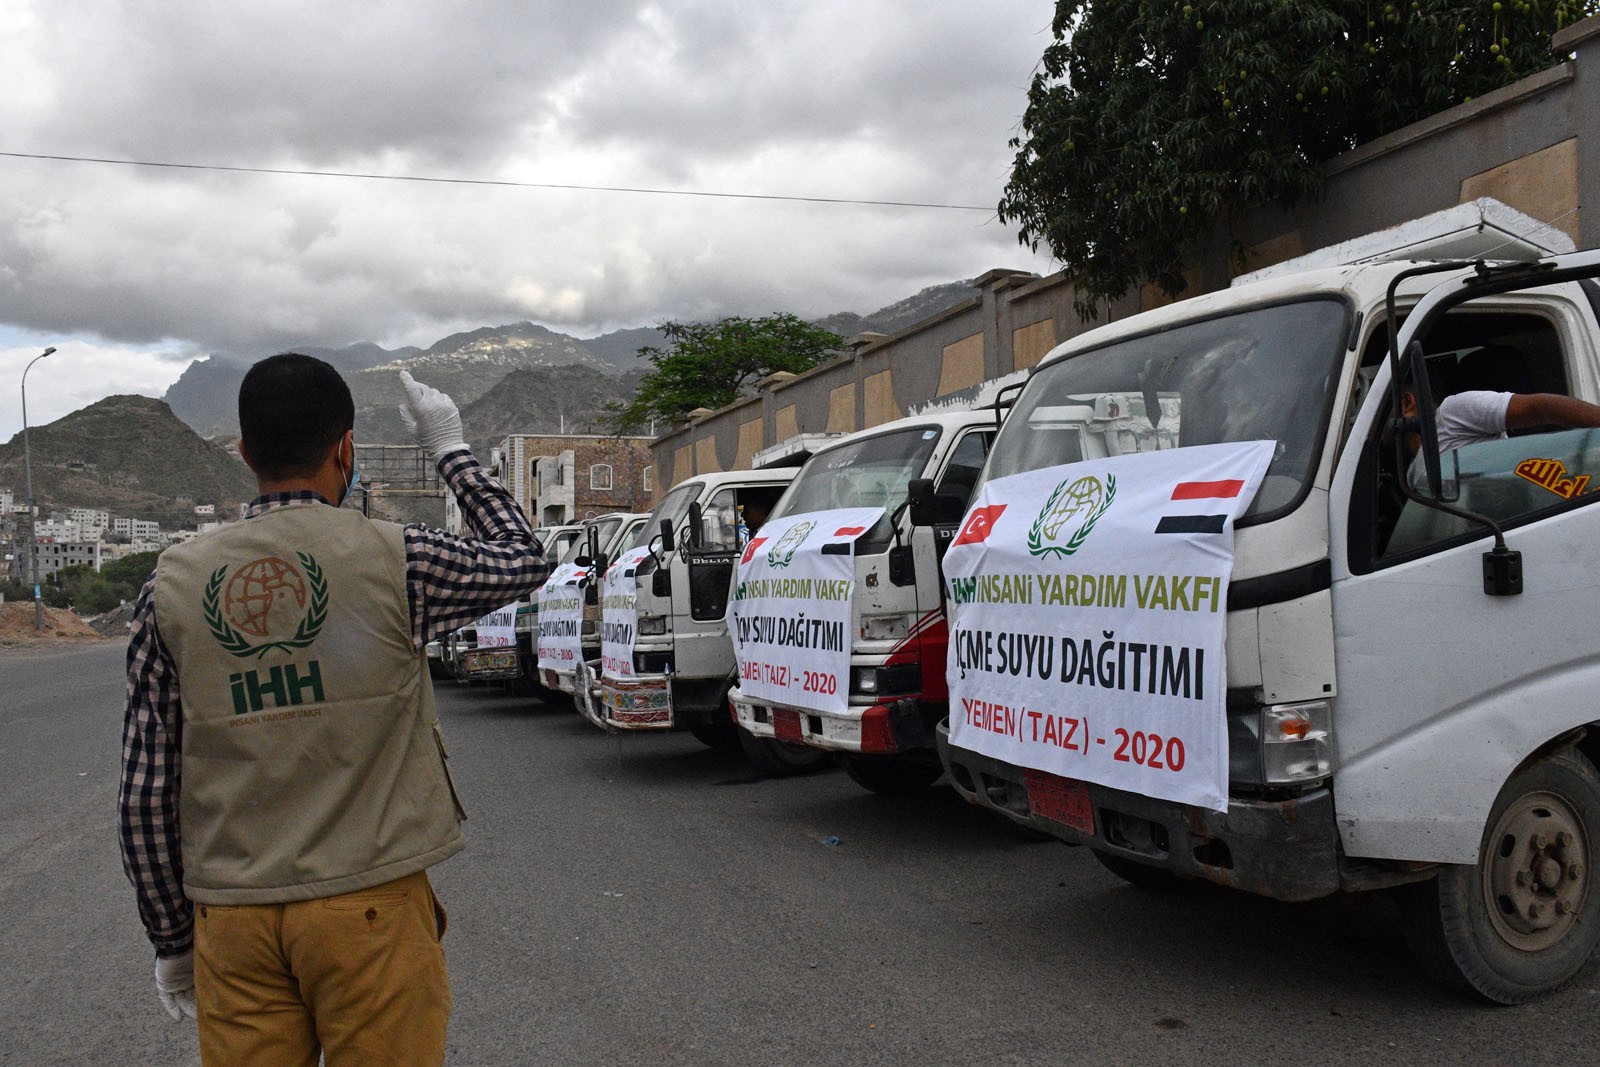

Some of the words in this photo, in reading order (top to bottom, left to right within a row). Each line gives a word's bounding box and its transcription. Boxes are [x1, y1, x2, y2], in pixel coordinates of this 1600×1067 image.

[771, 578, 812, 599] YARDIM
[814, 579, 852, 602] VAKFI
[1037, 574, 1127, 608] YARDIM
[1133, 575, 1221, 612] VAKFI
[778, 612, 844, 653] DAĞITIMI
[955, 620, 992, 680] İÇME
[997, 632, 1053, 680] SUYU
[1061, 630, 1205, 700] DAĞITIMI
[803, 670, 837, 695] 2020
[961, 697, 1015, 737] YEMEN
[1113, 727, 1186, 772] 2020
